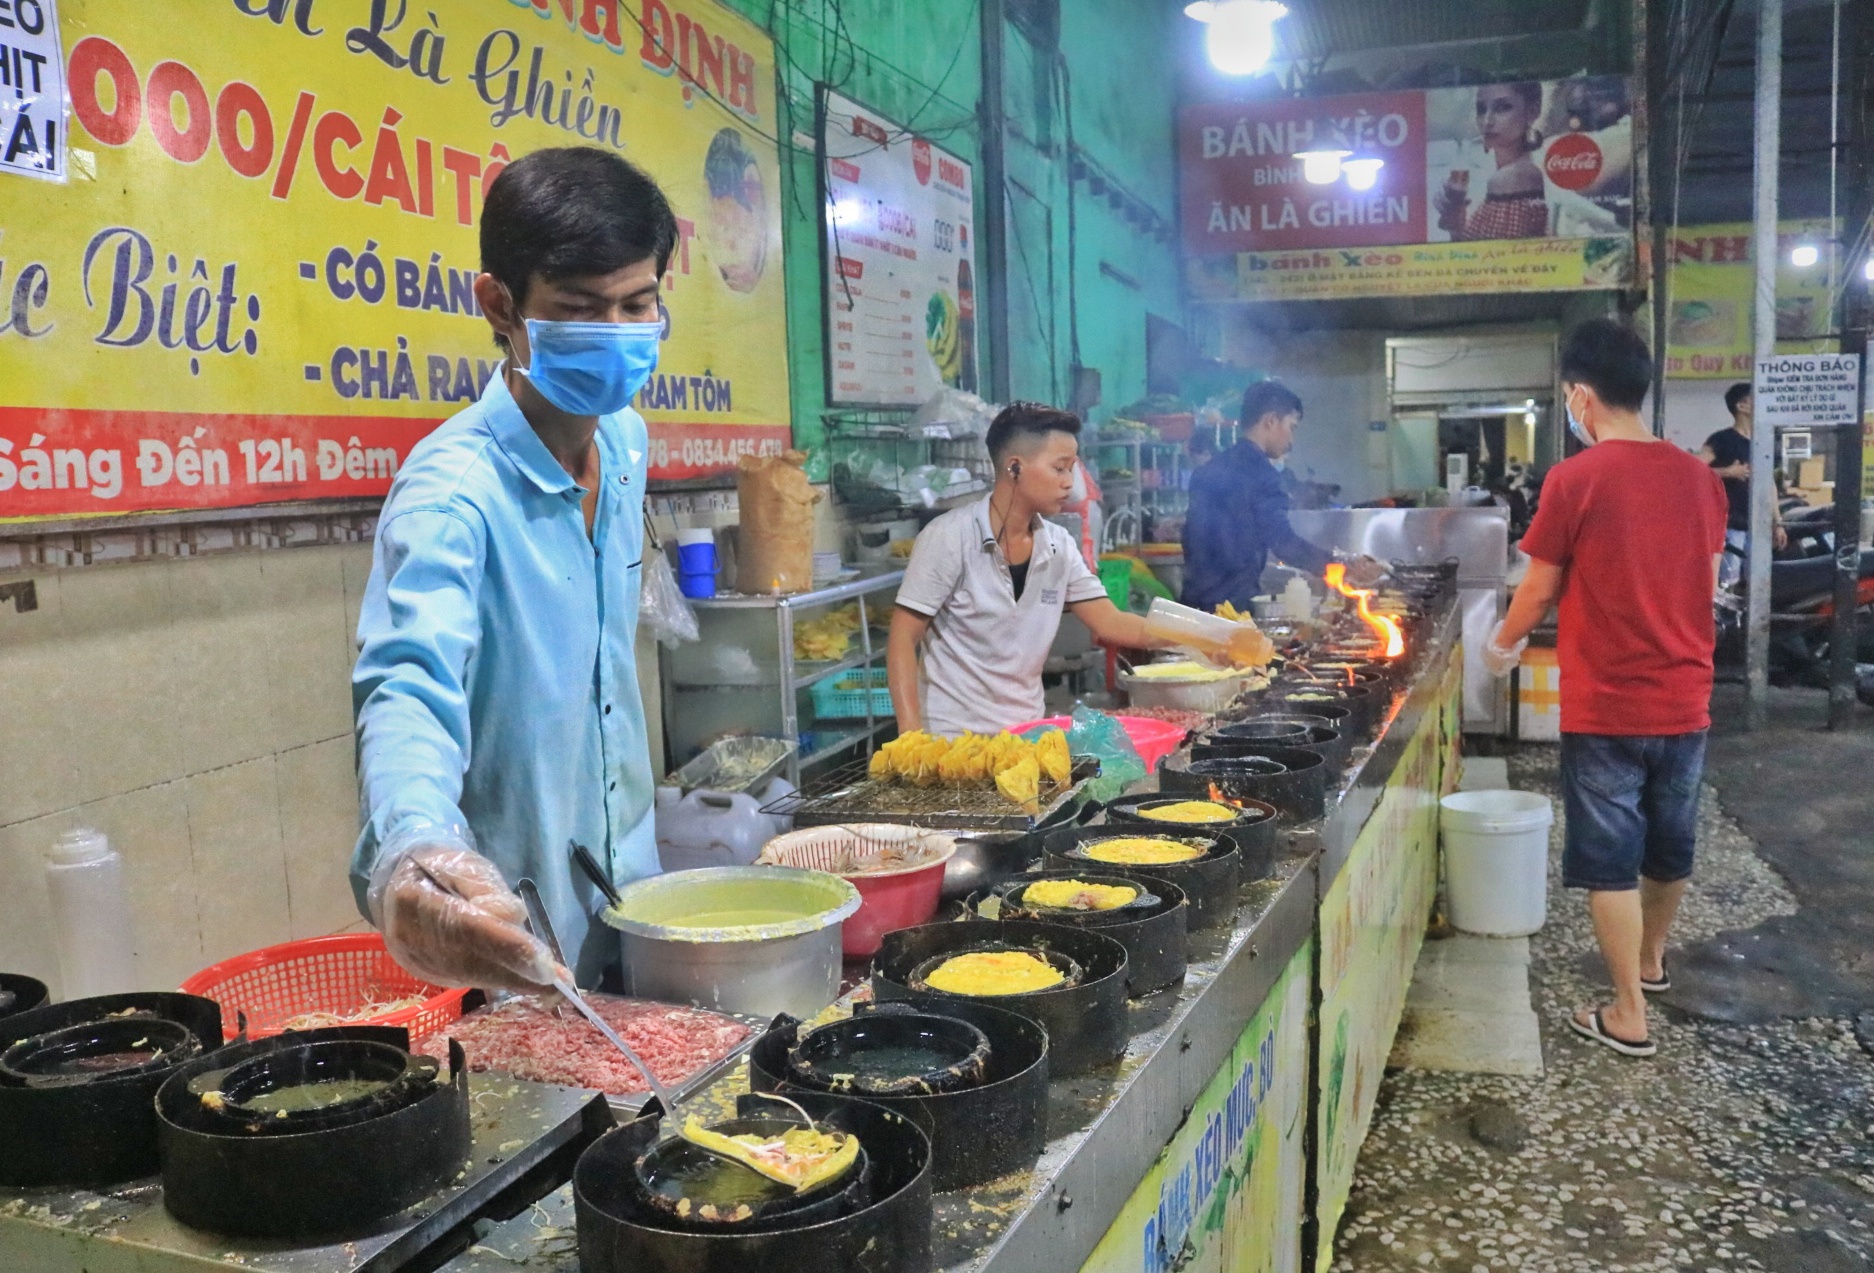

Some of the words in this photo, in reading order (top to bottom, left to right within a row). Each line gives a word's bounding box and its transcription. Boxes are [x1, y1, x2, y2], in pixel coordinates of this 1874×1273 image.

[346, 0, 450, 84] Là
[468, 29, 626, 149] Ghiền
[1202, 117, 1314, 159] BÁNH
[1207, 201, 1251, 233] ĂN
[1261, 197, 1300, 230] LÀ
[83, 227, 260, 376] Biệt:
[690, 368, 732, 412] TÔM
[1758, 360, 1815, 373] THÔNG
[1821, 357, 1856, 372] BÁO
[136, 426, 230, 486] Đến
[239, 436, 307, 483] 12h
[316, 435, 398, 481] Đêm
[1195, 1111, 1222, 1218] XÈO
